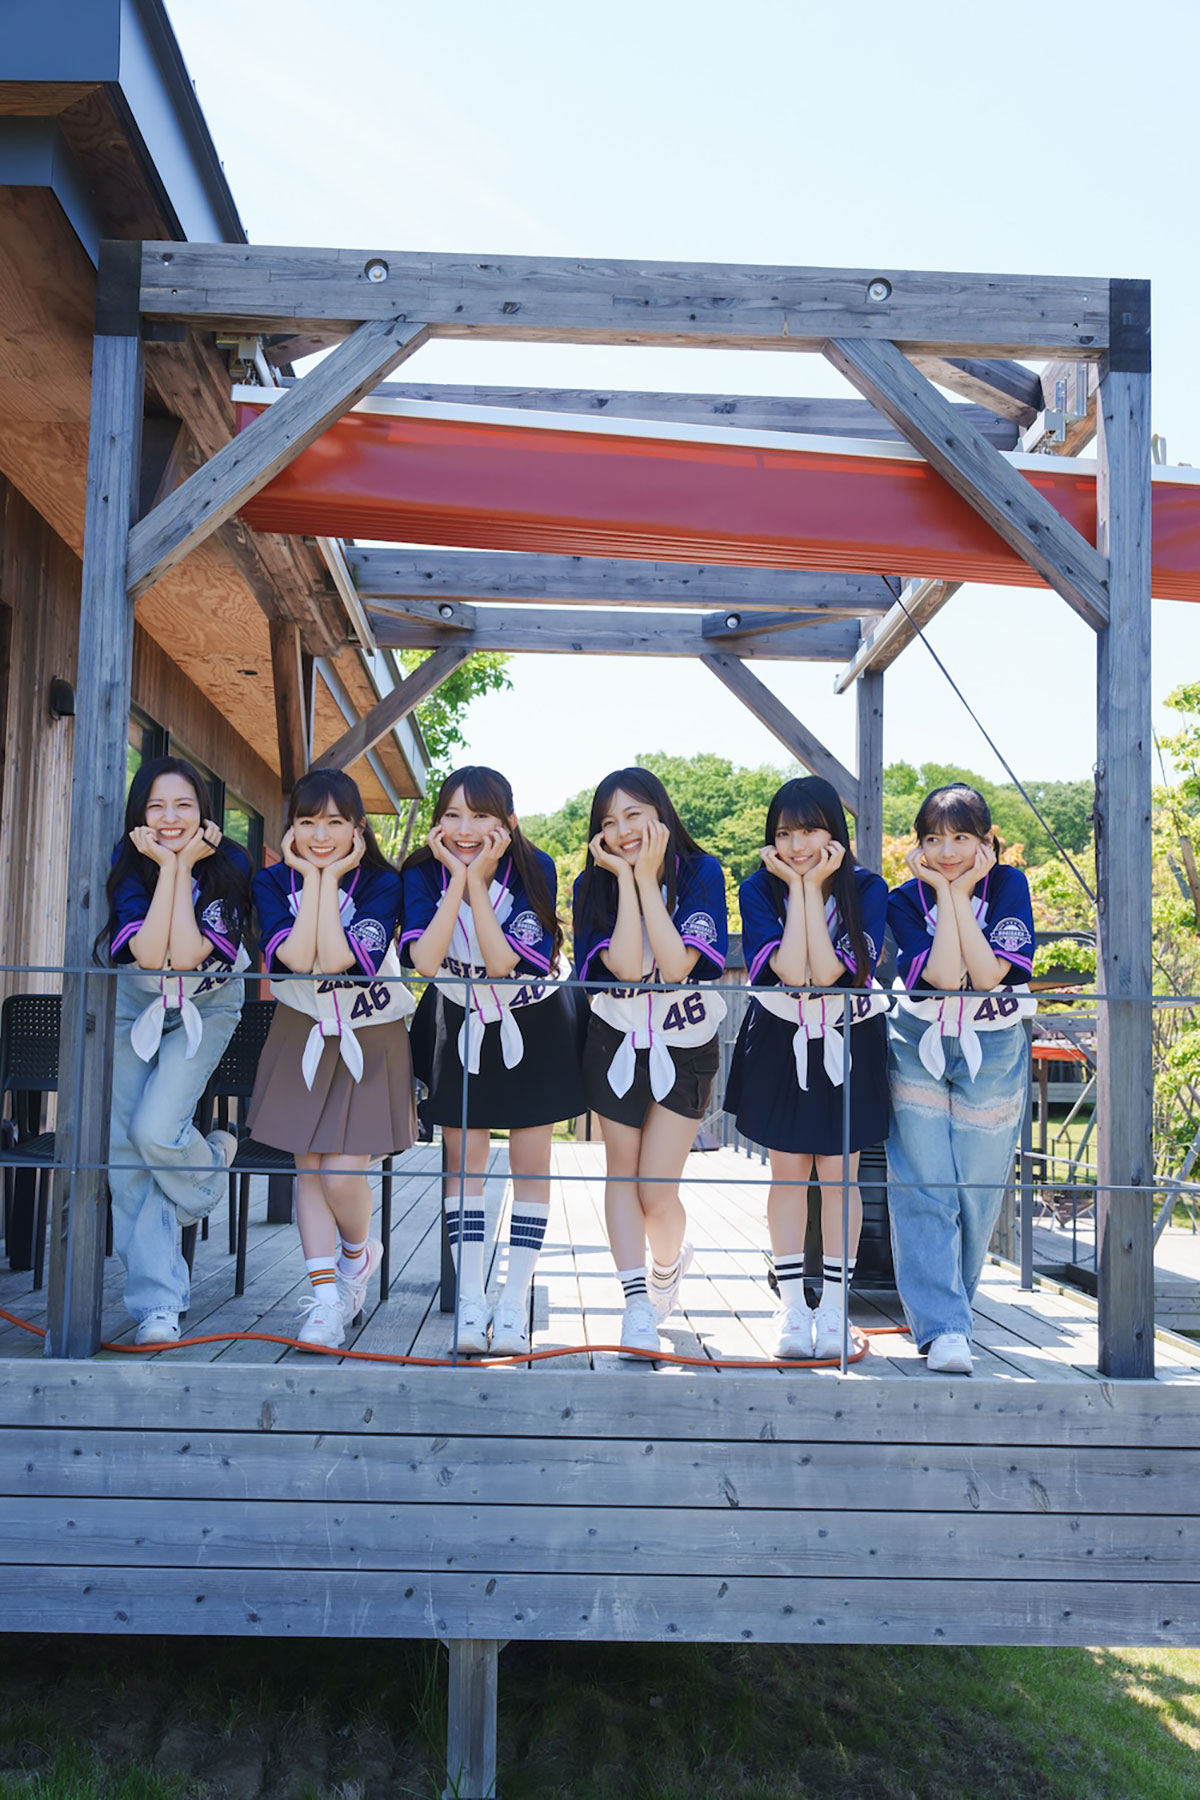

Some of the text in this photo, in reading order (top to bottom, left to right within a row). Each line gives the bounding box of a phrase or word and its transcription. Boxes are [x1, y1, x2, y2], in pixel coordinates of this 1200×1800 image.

[350, 980, 391, 1020] 46
[662, 991, 706, 1031] 46
[972, 985, 1019, 1021] 46
